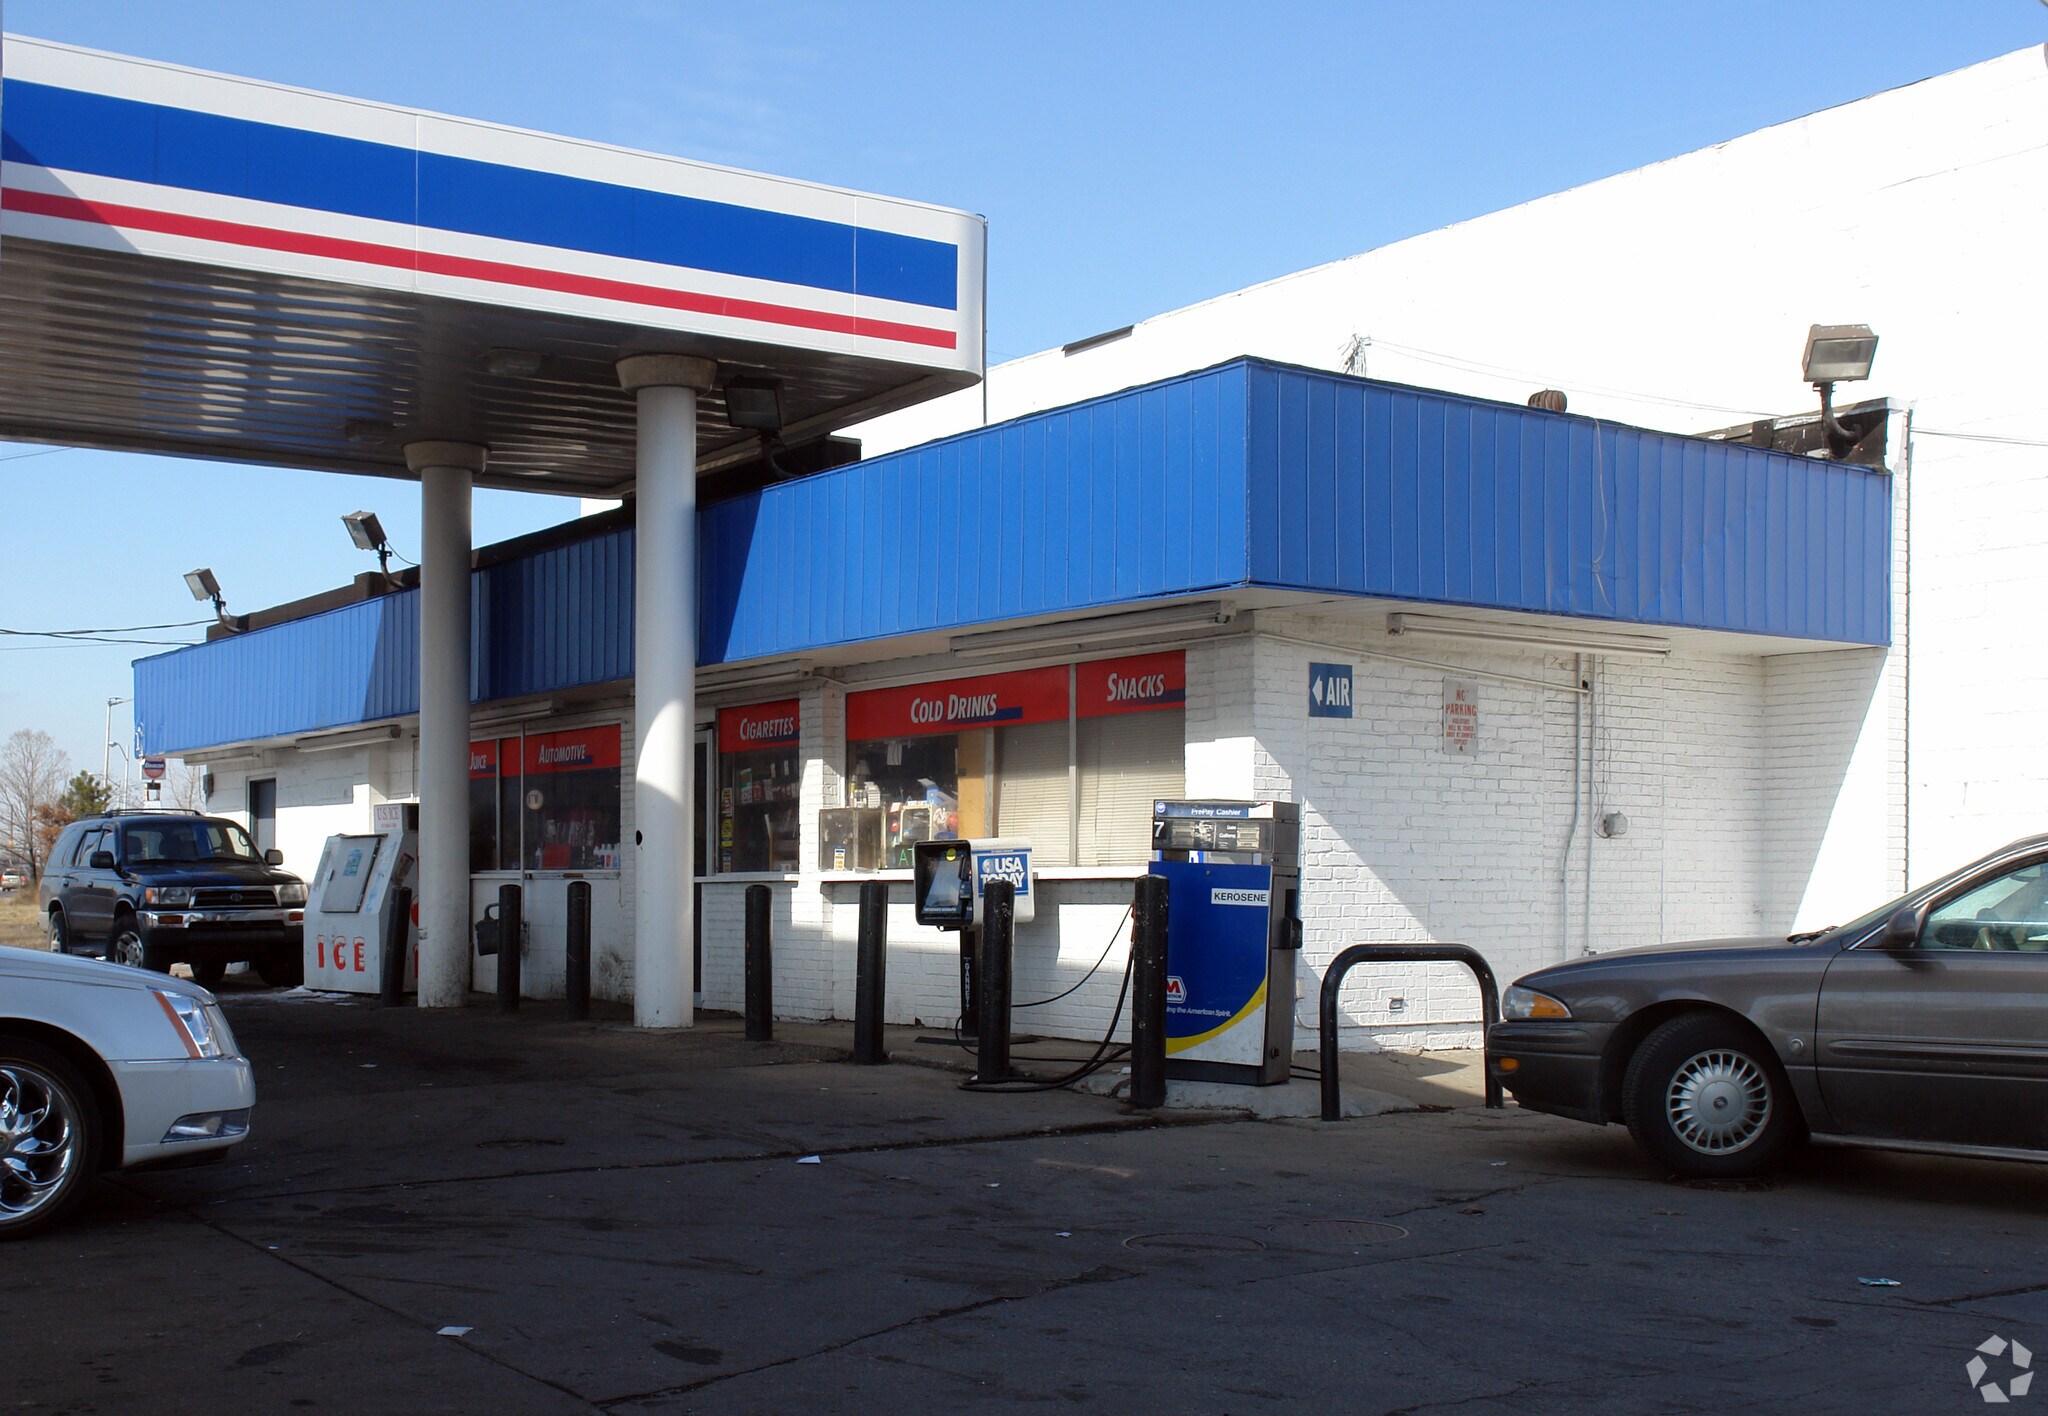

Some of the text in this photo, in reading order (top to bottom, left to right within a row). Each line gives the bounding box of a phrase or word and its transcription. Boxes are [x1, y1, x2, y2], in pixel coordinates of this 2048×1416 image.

[1106, 672, 1165, 702] SNACKS
[1326, 676, 1351, 707] AIR
[910, 693, 998, 724] COLD DRINKS
[1445, 704, 1477, 717] PARKING
[739, 717, 794, 741] CIGARETTES
[469, 752, 488, 771] JUICE
[538, 744, 586, 764] AUTOMOTIVE
[1190, 808, 1214, 816] PrePay
[1154, 822, 1165, 838] 7
[994, 856, 1024, 873] USA
[1214, 892, 1267, 902] KEROSENE
[317, 934, 366, 972] ICE
[1166, 980, 1181, 993] M
[1186, 1007, 1215, 1016] American
